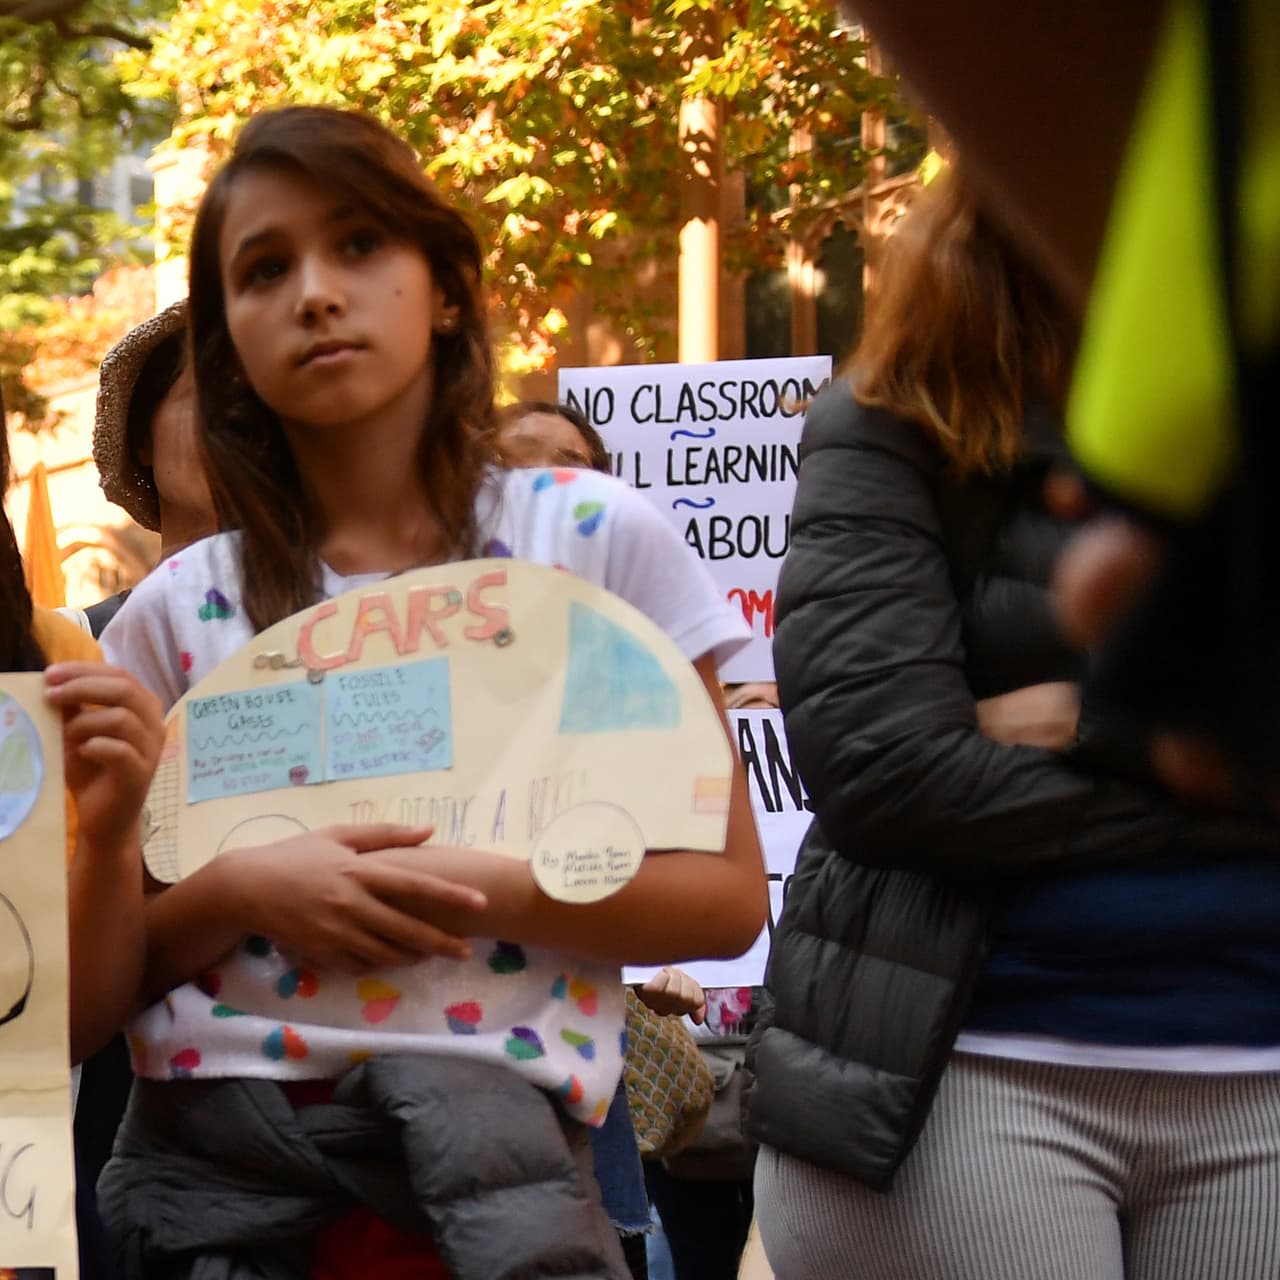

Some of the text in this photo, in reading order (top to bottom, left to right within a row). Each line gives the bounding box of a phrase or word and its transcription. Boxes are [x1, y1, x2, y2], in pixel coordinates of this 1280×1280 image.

[567, 387, 615, 425] NO
[666, 443, 801, 487] LEARNIN
[685, 514, 790, 560] ABOU
[300, 571, 509, 671] CARS
